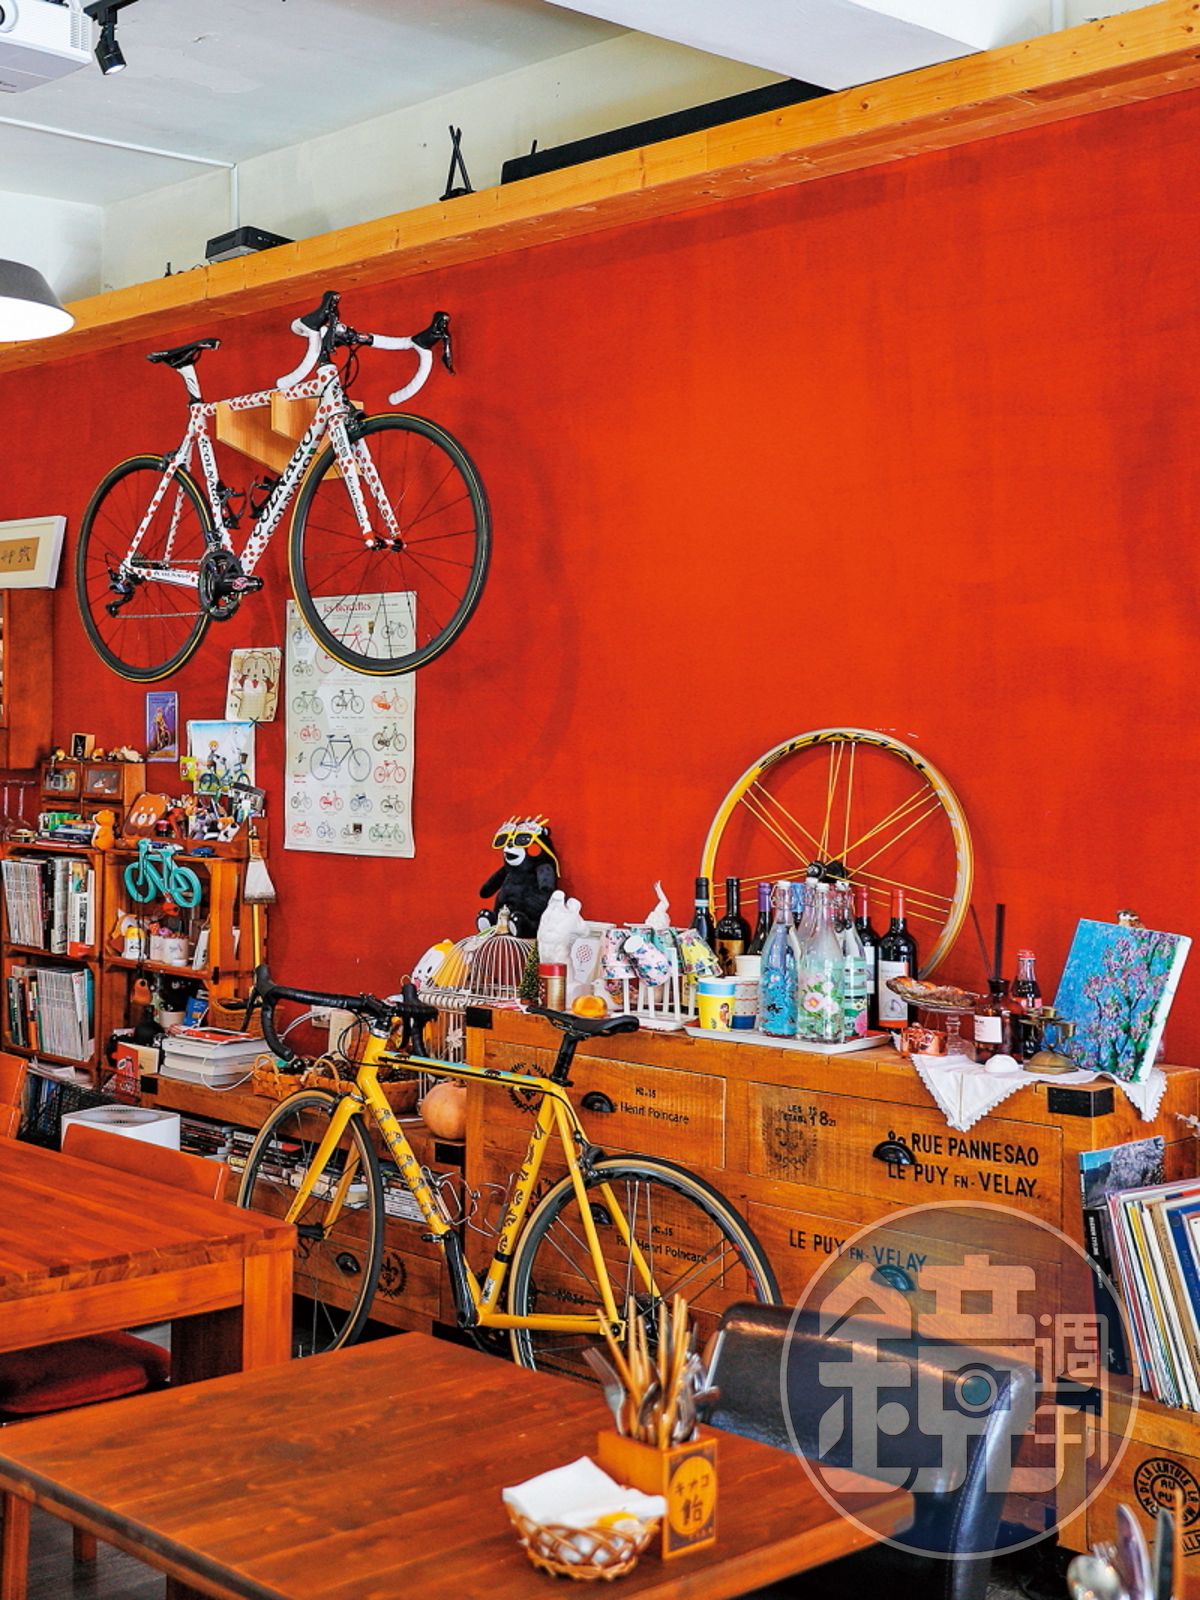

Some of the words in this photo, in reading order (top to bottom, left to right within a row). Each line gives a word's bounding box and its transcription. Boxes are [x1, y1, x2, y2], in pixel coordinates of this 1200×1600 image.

[202, 443, 220, 506] COLNAGO
[253, 428, 312, 537] COLNAGO
[620, 1101, 646, 1116] Henri
[648, 1106, 690, 1125] Poincare
[912, 1133, 942, 1155] RUE
[888, 1162, 905, 1180] LE
[914, 1164, 948, 1185] PUY
[665, 1245, 708, 1264] Poincare
[789, 1229, 806, 1249] LE
[813, 1234, 846, 1257] PUY
[873, 1246, 927, 1273] VELAY
